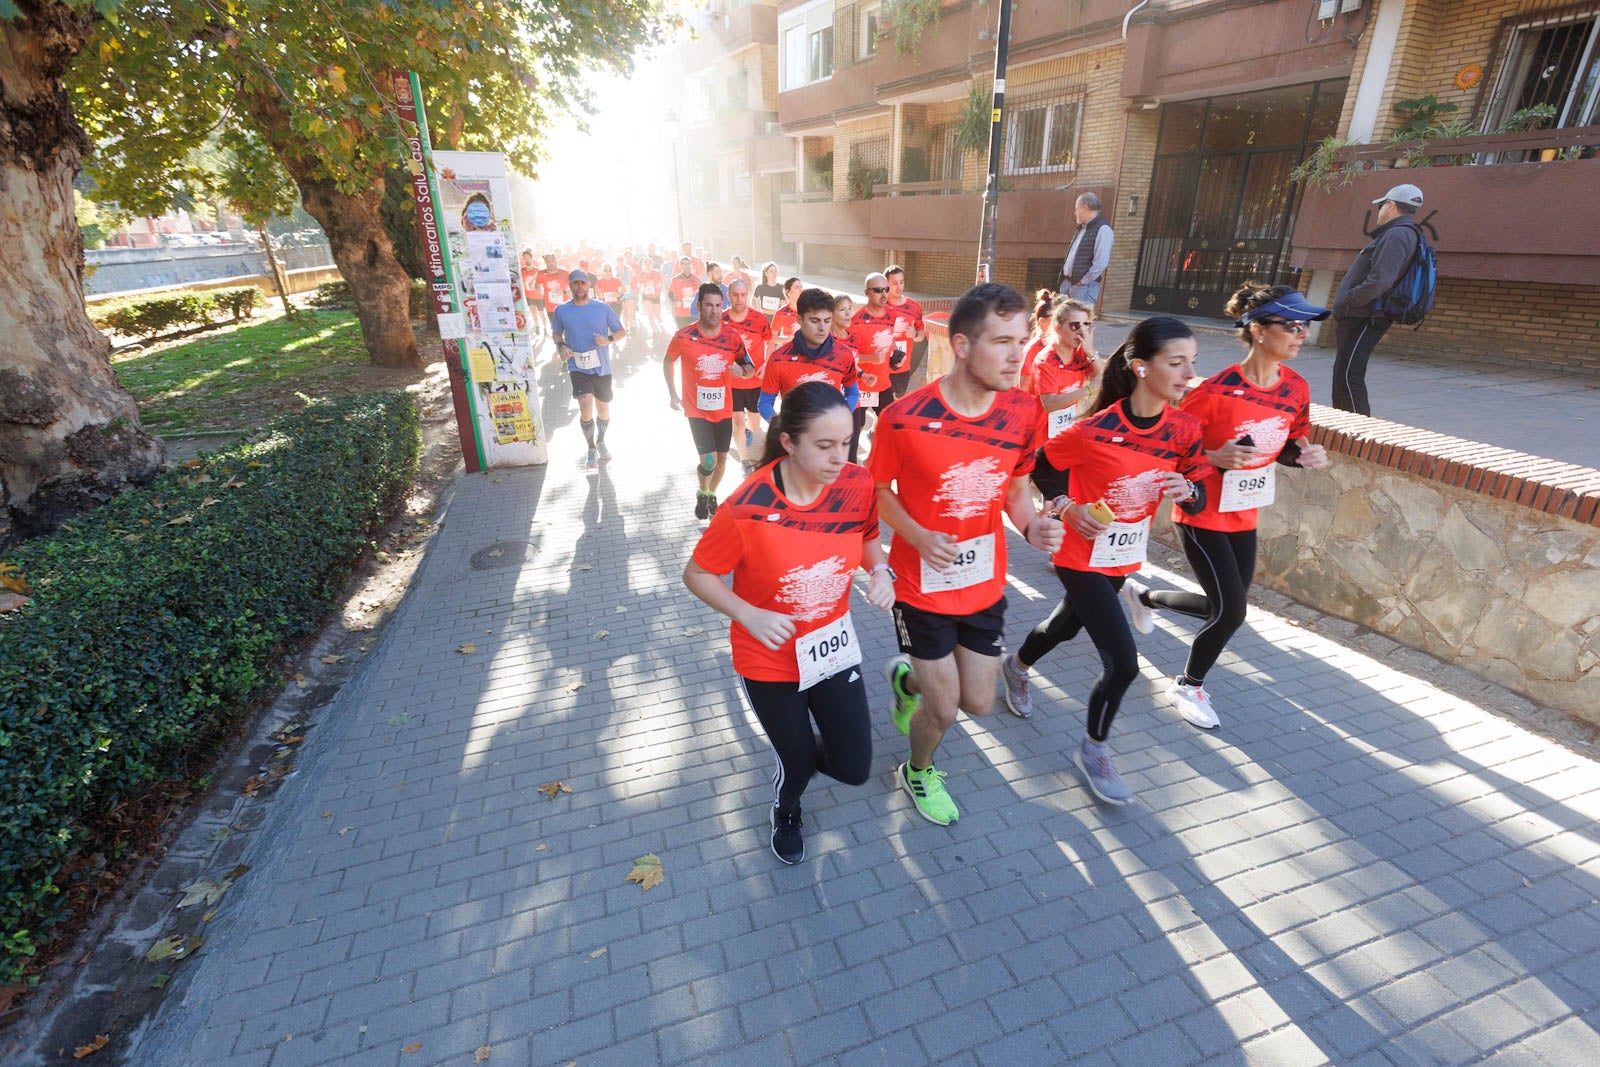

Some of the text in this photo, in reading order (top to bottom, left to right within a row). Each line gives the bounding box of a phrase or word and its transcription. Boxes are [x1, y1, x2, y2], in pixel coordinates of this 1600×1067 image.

[1246, 130, 1255, 145] 2
[433, 284, 453, 292] MPS
[701, 392, 722, 400] 1053
[1238, 476, 1266, 492] 998
[1107, 531, 1143, 547] 1001
[782, 574, 850, 595] carrera
[808, 630, 849, 662] 1090
